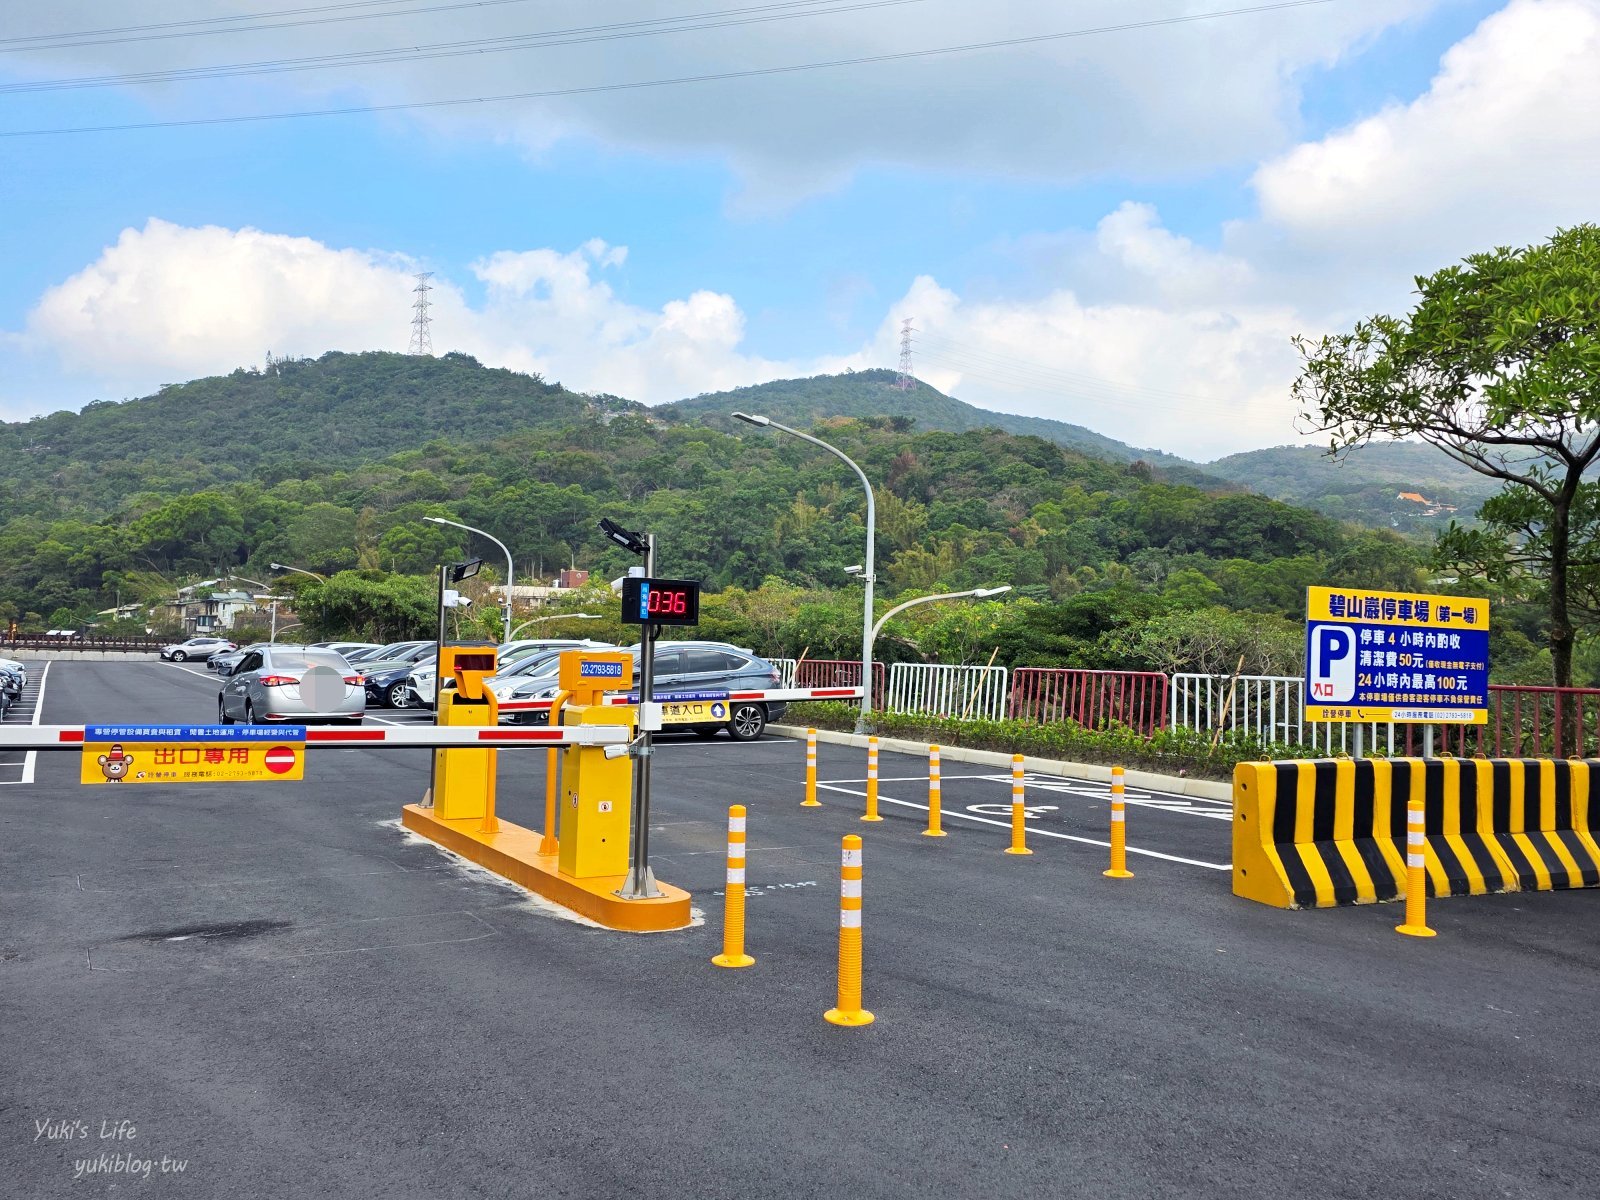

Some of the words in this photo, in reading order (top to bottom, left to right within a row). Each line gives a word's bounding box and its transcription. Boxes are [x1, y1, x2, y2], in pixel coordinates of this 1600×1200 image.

[648, 591, 686, 613] 036
[581, 664, 622, 675] 02-2793-5818
[1313, 683, 1334, 697] 入口
[154, 747, 249, 765] 出口專用
